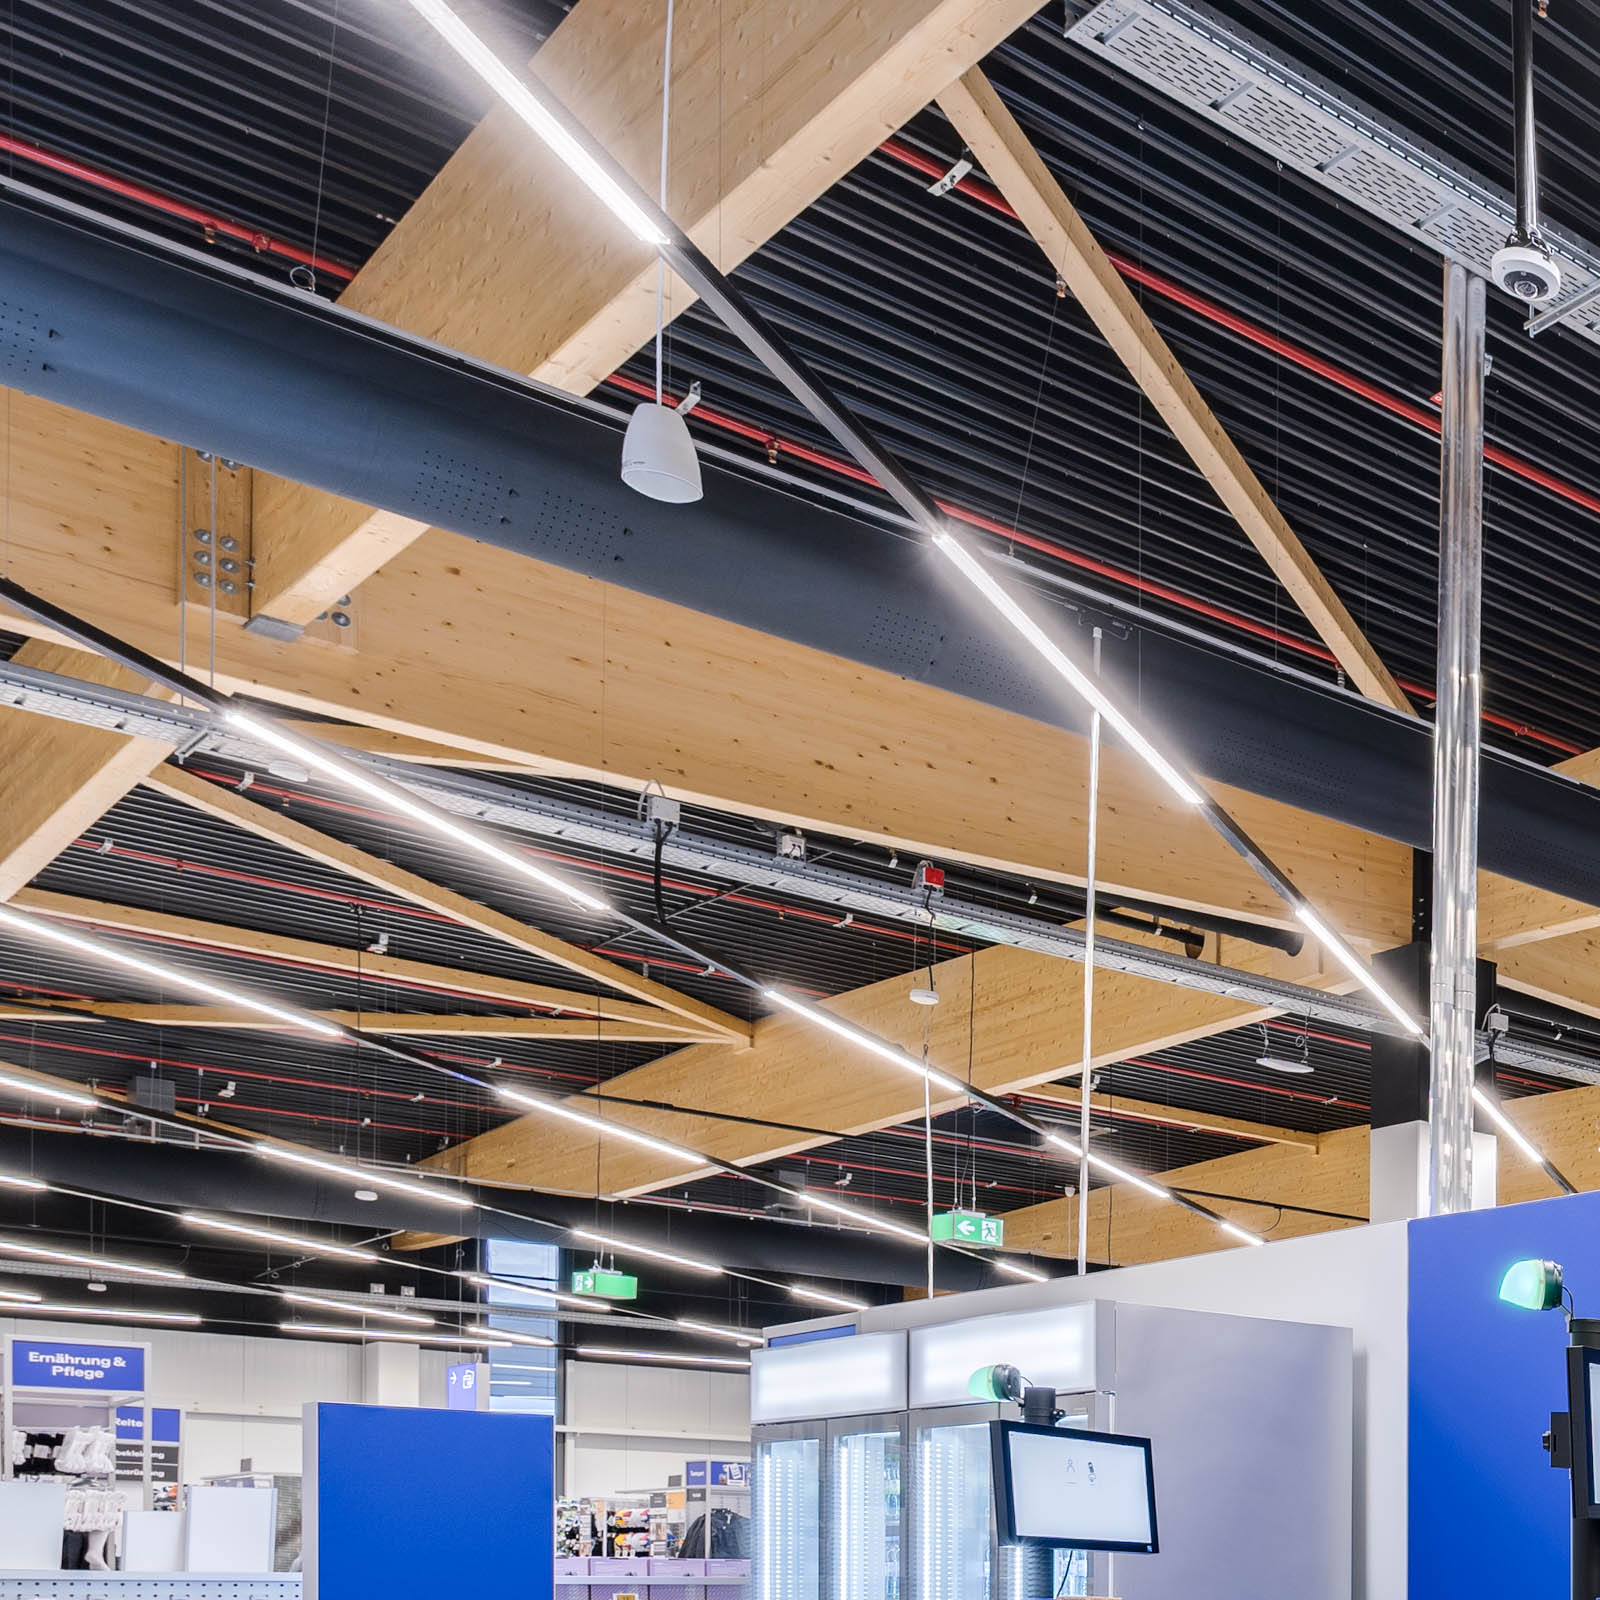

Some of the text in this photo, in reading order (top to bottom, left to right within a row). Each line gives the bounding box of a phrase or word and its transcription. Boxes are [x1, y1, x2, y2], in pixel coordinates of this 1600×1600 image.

[29, 1351, 127, 1368] Ernährung &
[52, 1365, 105, 1380] Pflege
